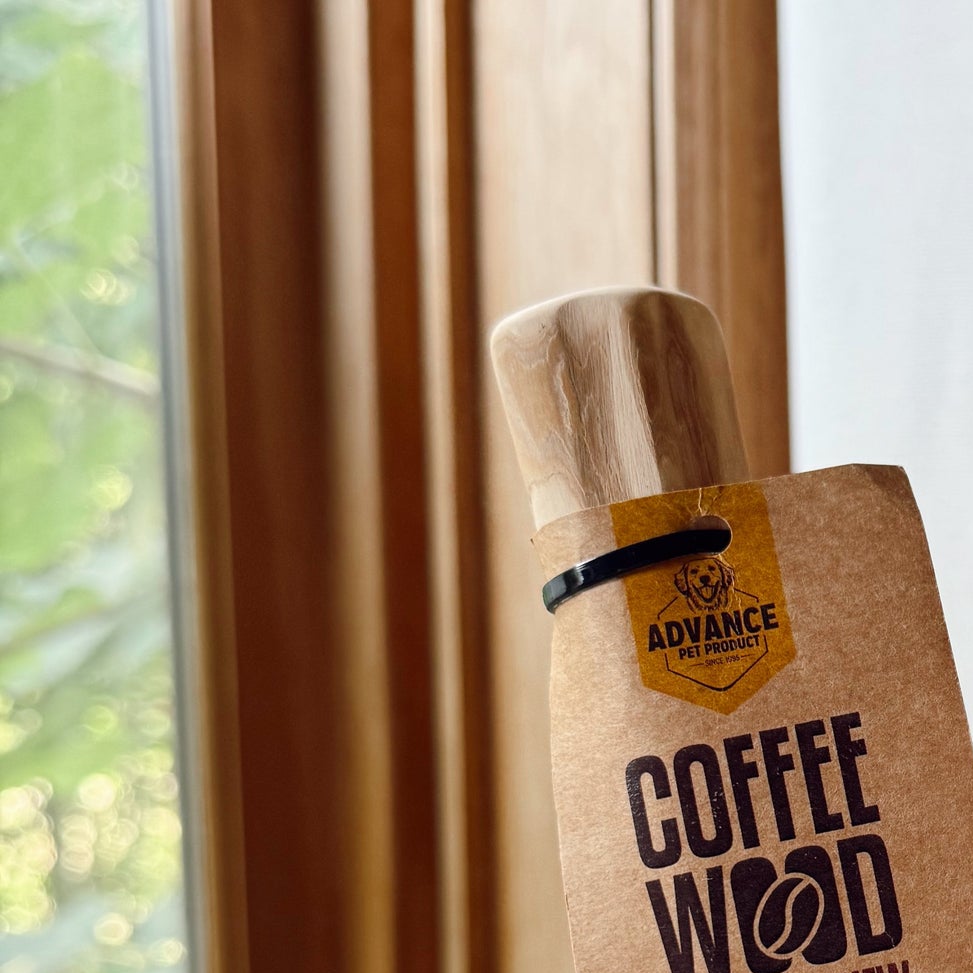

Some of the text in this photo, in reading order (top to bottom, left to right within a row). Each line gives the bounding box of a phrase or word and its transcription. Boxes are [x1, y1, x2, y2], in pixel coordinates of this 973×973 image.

[648, 602, 779, 652] ADVANCE
[678, 635, 760, 660] PET PRODUCT
[625, 711, 881, 869] COFFEE
